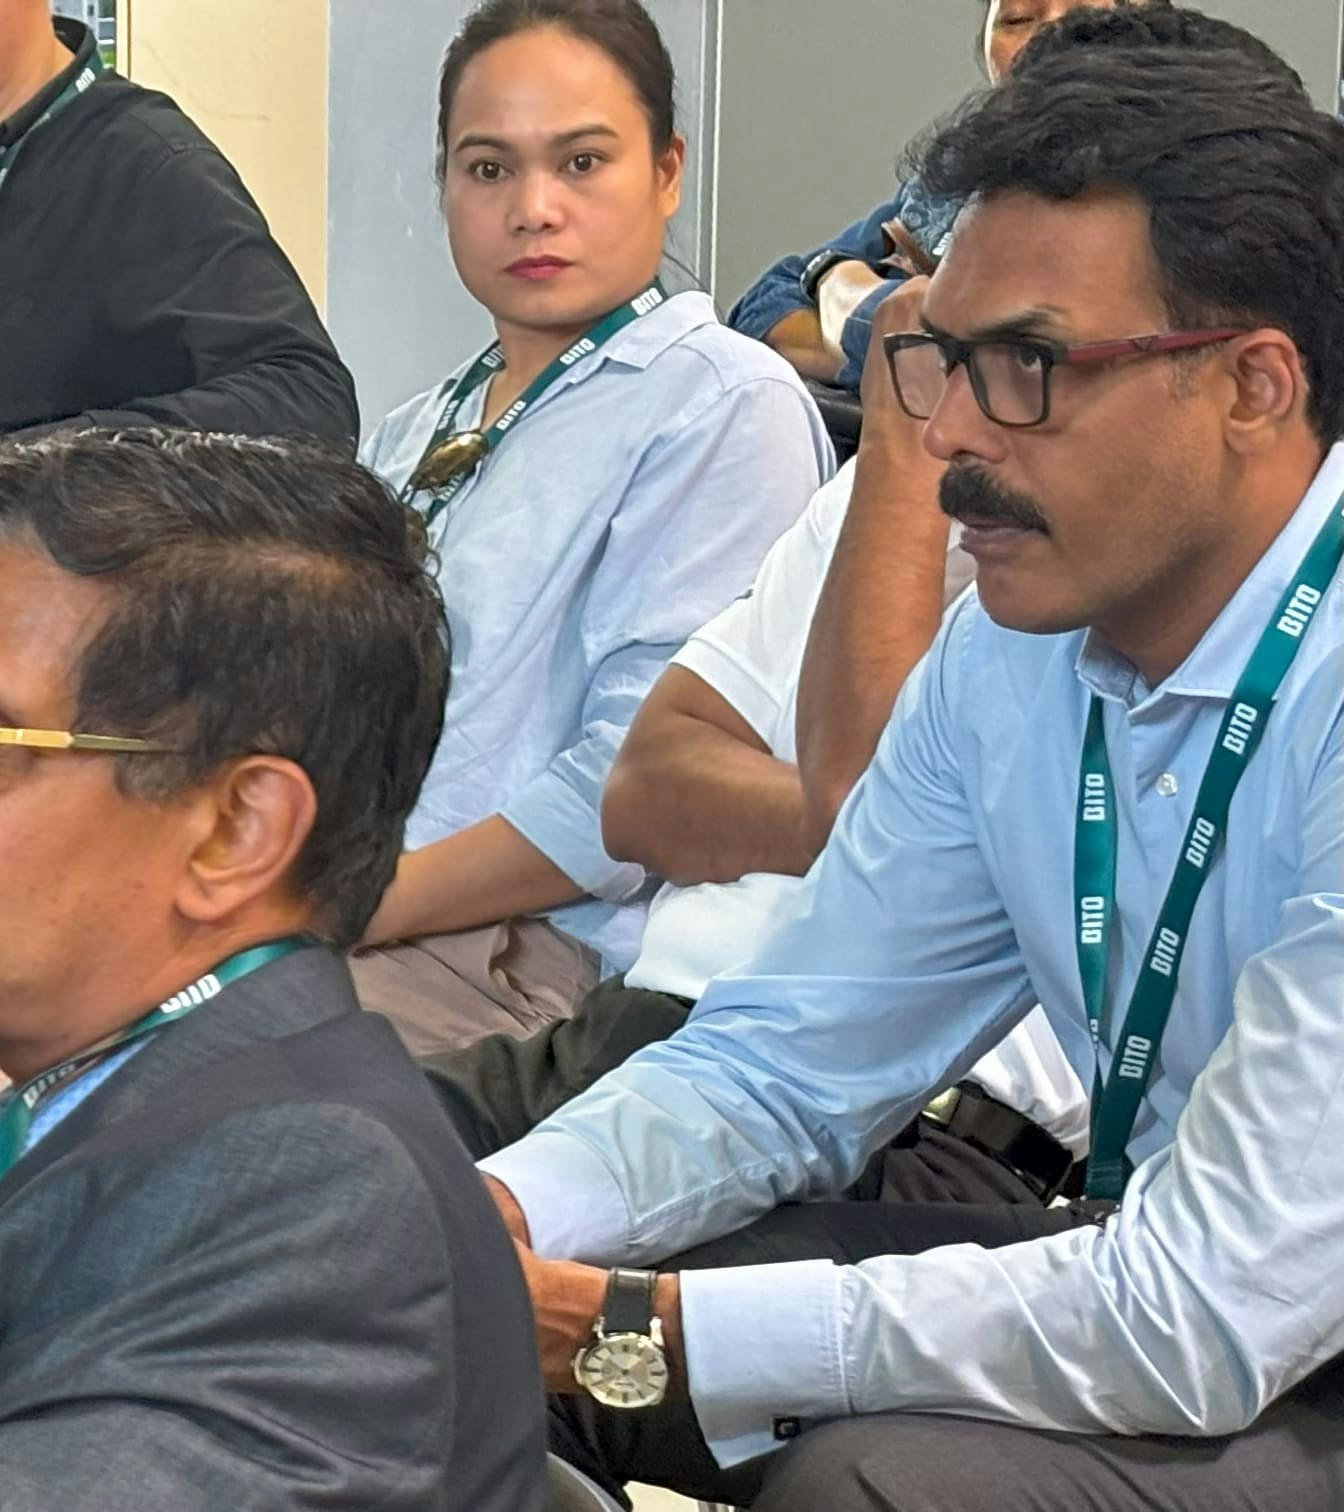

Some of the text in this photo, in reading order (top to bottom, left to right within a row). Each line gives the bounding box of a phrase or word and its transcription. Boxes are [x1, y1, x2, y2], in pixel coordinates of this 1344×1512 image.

[630, 287, 663, 316] BITO
[560, 337, 596, 366] BITO
[495, 399, 526, 431] BITO
[1276, 583, 1322, 638] BITO
[1222, 702, 1258, 755] BITO
[1083, 773, 1106, 822] BITO
[1185, 817, 1216, 868] BITO
[1081, 896, 1105, 945] BITO
[1150, 927, 1180, 976] BITO
[1118, 1035, 1151, 1079] BITO
